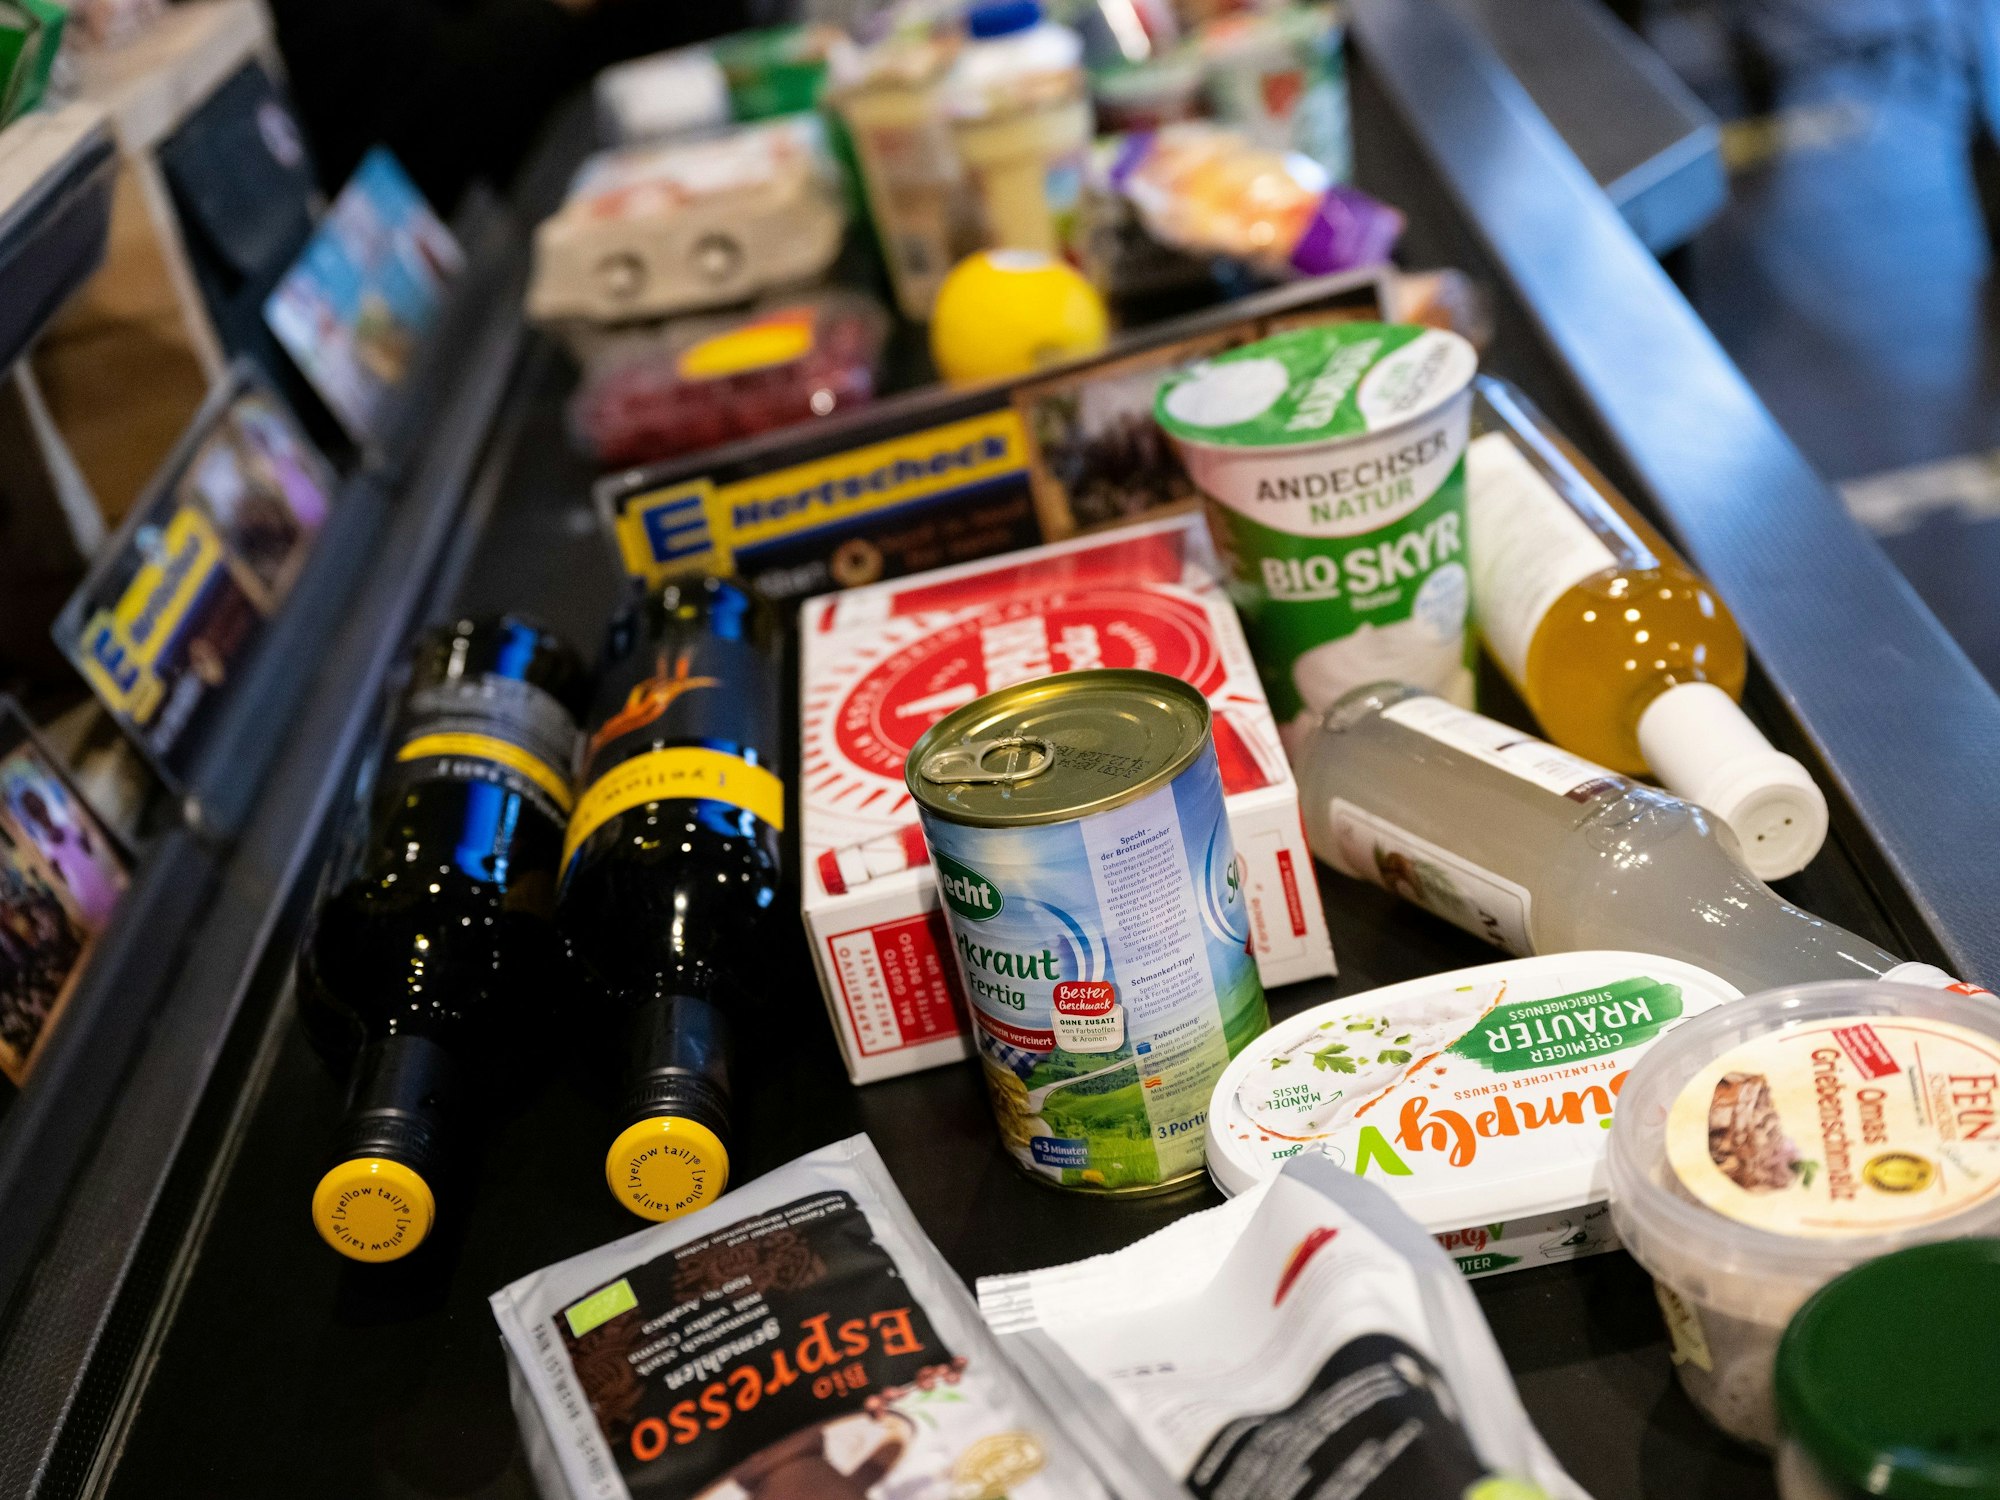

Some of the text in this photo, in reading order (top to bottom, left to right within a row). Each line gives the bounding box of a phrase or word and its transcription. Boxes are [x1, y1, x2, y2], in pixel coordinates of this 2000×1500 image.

[1256, 428, 1449, 503] ANDECHSER
[1308, 475, 1415, 526] NATUR
[1260, 511, 1461, 594] BIO SKYR
[1100, 828, 1169, 860] der Brotzeitmacher
[1120, 829, 1145, 844] Specht
[1102, 859, 1127, 871] Daheim
[1103, 844, 1174, 879] schen Pfarrkirchen wird
[1118, 871, 1140, 883] unsere
[1141, 854, 1174, 874] Schmankerl
[1109, 876, 1182, 911] eingelegt und reift durch
[1111, 877, 1147, 894] feldfrischer
[1119, 878, 1163, 899] kontrolliertem
[1164, 869, 1181, 880] Anbau
[1115, 903, 1147, 917] natürliche
[1118, 914, 1141, 926] gärung
[1122, 903, 1180, 932] Verfeinert mit Wein
[1118, 932, 1131, 941] und
[1132, 921, 1163, 937] Gewürzen
[1164, 913, 1177, 923] wird
[1123, 917, 1186, 948] Sauerkraut schonend
[1136, 929, 1178, 952] vorgegart und
[1168, 932, 1191, 947] Minuten
[1131, 953, 1194, 986] Schmankerl-Tipp!
[1139, 966, 1193, 994] Specht Sauerkraut
[969, 971, 1026, 1011] Fertig
[1060, 985, 1109, 1000] Bester
[1144, 985, 1190, 1008] Hausmannskost
[1191, 977, 1203, 987] oder
[1151, 987, 1170, 997] Fertig
[1059, 1000, 1112, 1012] Geschmack
[1139, 1006, 1162, 1018] einfach
[1509, 992, 1611, 1020] STREICHGENUSS
[1075, 1026, 1116, 1035] Farbstoffen
[1084, 1017, 1115, 1026] ZUSATZ
[1153, 1017, 1199, 1040] Zubereitung:
[1487, 998, 1651, 1052] KRÄUTER
[1010, 1032, 1053, 1047] verfeinert
[1079, 1035, 1107, 1043] Aromen
[1531, 1033, 1622, 1062] CREMIGER
[1143, 1052, 1162, 1063] geben
[1163, 1046, 1175, 1055] und
[1273, 1084, 1308, 1097] BASIS
[1454, 1061, 1615, 1100] PFLANZLICHER GENUSS
[1266, 1092, 1320, 1109] MANDEL
[1298, 1104, 1312, 1113] AUF
[1158, 1112, 1207, 1139] 3 Porti
[1811, 1046, 1855, 1203] Griebenschmalz
[1857, 1087, 1888, 1147] Omas
[1042, 1140, 1050, 1153] 3
[1051, 1143, 1088, 1155] Minuten
[1042, 1155, 1087, 1165] zubereitet
[628, 1292, 761, 1363] mit voller Crema
[642, 1300, 699, 1333] Arabica
[665, 1318, 781, 1390] gemahlen
[630, 1308, 924, 1462] Espresso
[813, 1363, 869, 1400] Bio
